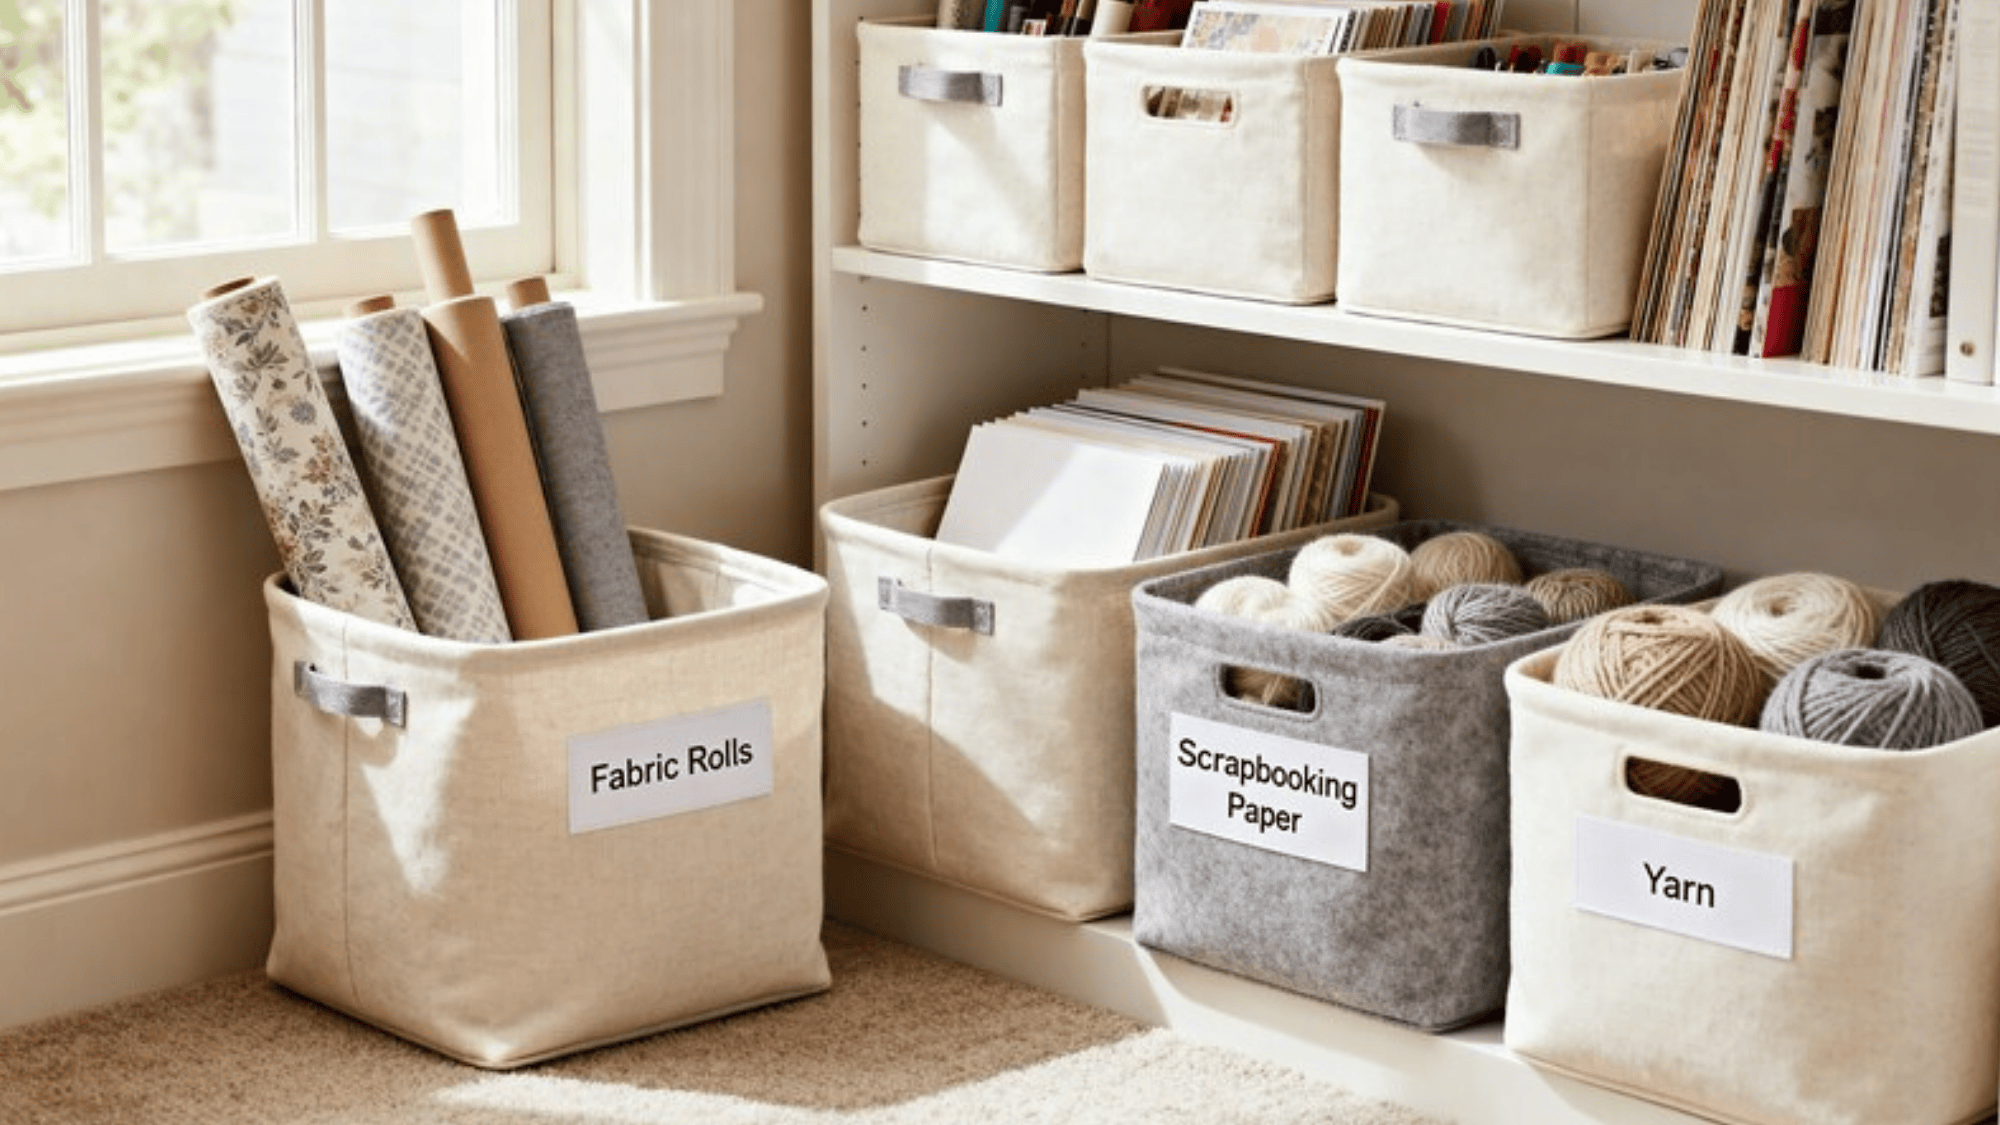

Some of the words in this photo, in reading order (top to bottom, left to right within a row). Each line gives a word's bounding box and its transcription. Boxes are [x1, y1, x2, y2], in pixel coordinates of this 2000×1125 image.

[591, 753, 680, 794] Fabric
[688, 737, 753, 775] Rolls
[1177, 737, 1358, 811] Scrapbooking
[1227, 791, 1303, 834] Paper
[1643, 862, 1716, 909] Yarn
